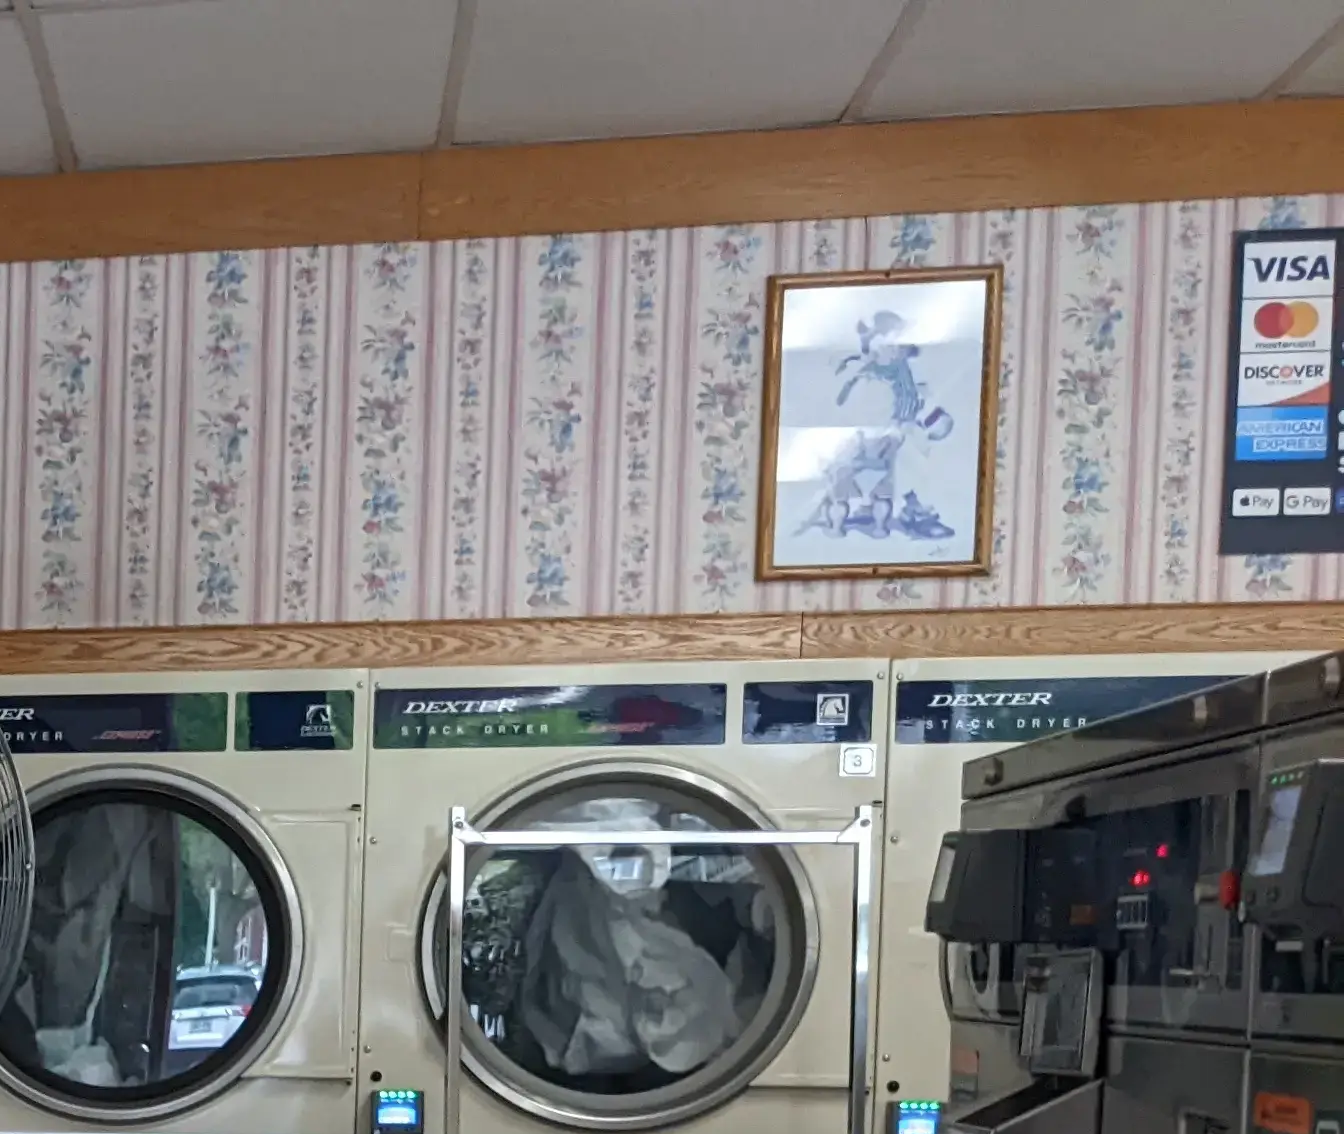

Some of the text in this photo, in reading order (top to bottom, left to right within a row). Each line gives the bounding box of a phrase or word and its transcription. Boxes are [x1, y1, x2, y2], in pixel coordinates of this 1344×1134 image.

[1248, 255, 1330, 282] VISA
[1244, 365, 1325, 379] DISCOVER
[1252, 496, 1274, 509] Pay
[1303, 495, 1328, 512] Pay
[403, 698, 519, 714] DEXTER
[927, 692, 1053, 707] DEXTER
[400, 724, 550, 737] STACK DRYER
[925, 717, 1087, 730] STACK DRYER
[853, 754, 862, 767] 3
